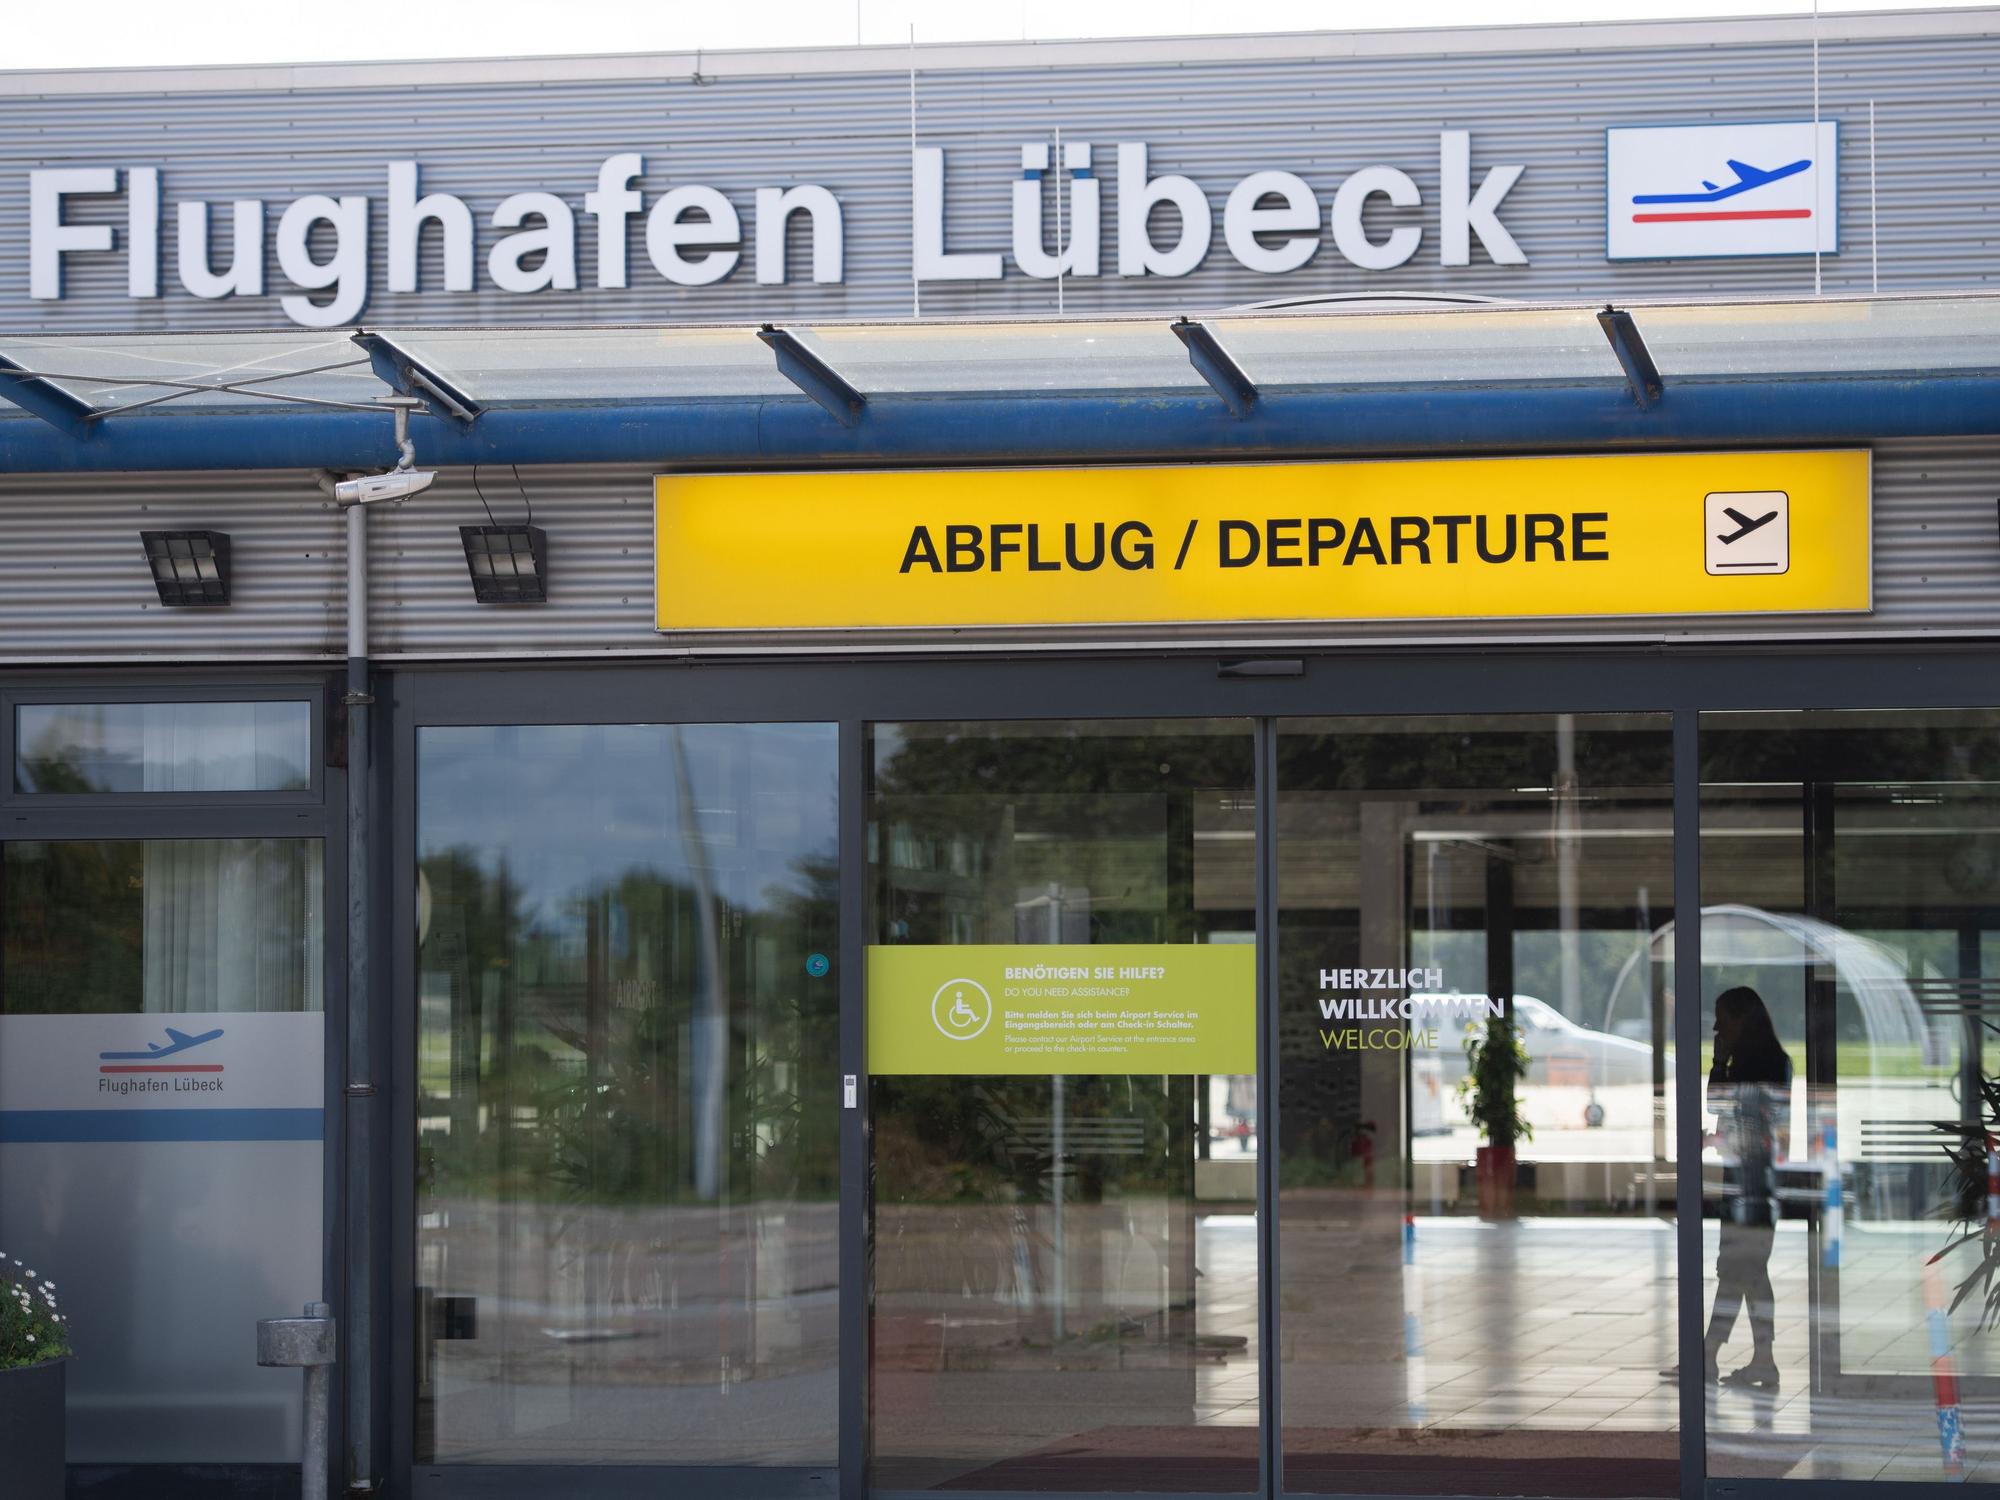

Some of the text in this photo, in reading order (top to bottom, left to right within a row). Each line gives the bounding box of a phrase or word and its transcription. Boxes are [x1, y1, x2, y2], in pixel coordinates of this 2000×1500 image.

[29, 129, 1530, 328] Flughafen Lübeck
[899, 512, 1610, 574] ABFLUG / DEPARTURE
[1004, 963, 1166, 980] BENÖTIGEN SIE HILFE?
[1319, 967, 1443, 989] HERZLICH
[1004, 986, 1130, 997] DO YOU NEED ASSISTANCE?
[1004, 1010, 1199, 1021] Bitte melden Sie sich beim Airport Service im
[1318, 998, 1505, 1020] WILLKOMMEN
[1004, 1020, 1076, 1031] Eingangsbereich
[1078, 1020, 1098, 1029] oder
[1117, 1020, 1155, 1029] Check-in
[1319, 1028, 1439, 1050] WELCOME
[99, 1077, 224, 1096] Flughafen Lübeck
